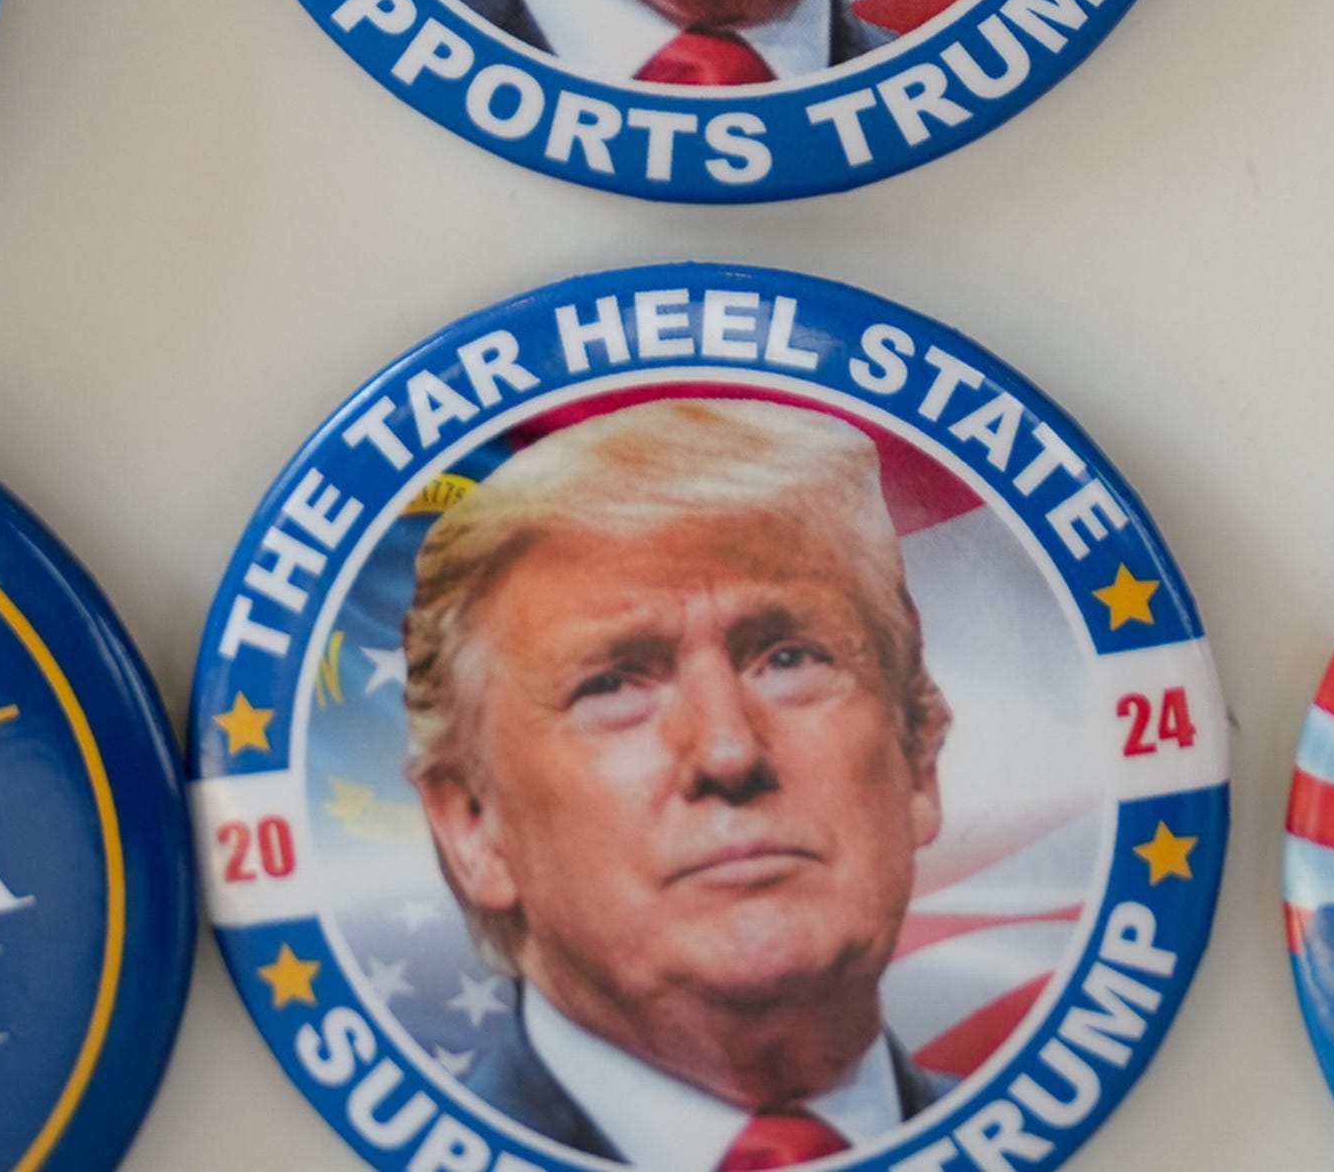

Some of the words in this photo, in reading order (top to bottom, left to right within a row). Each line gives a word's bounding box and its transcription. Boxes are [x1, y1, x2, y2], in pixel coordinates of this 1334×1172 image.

[217, 468, 364, 662] THE
[342, 329, 543, 475] TAR
[553, 288, 821, 374] HEEL
[848, 323, 1128, 561] STATE
[1115, 686, 1196, 757] 24
[216, 814, 298, 882] 20
